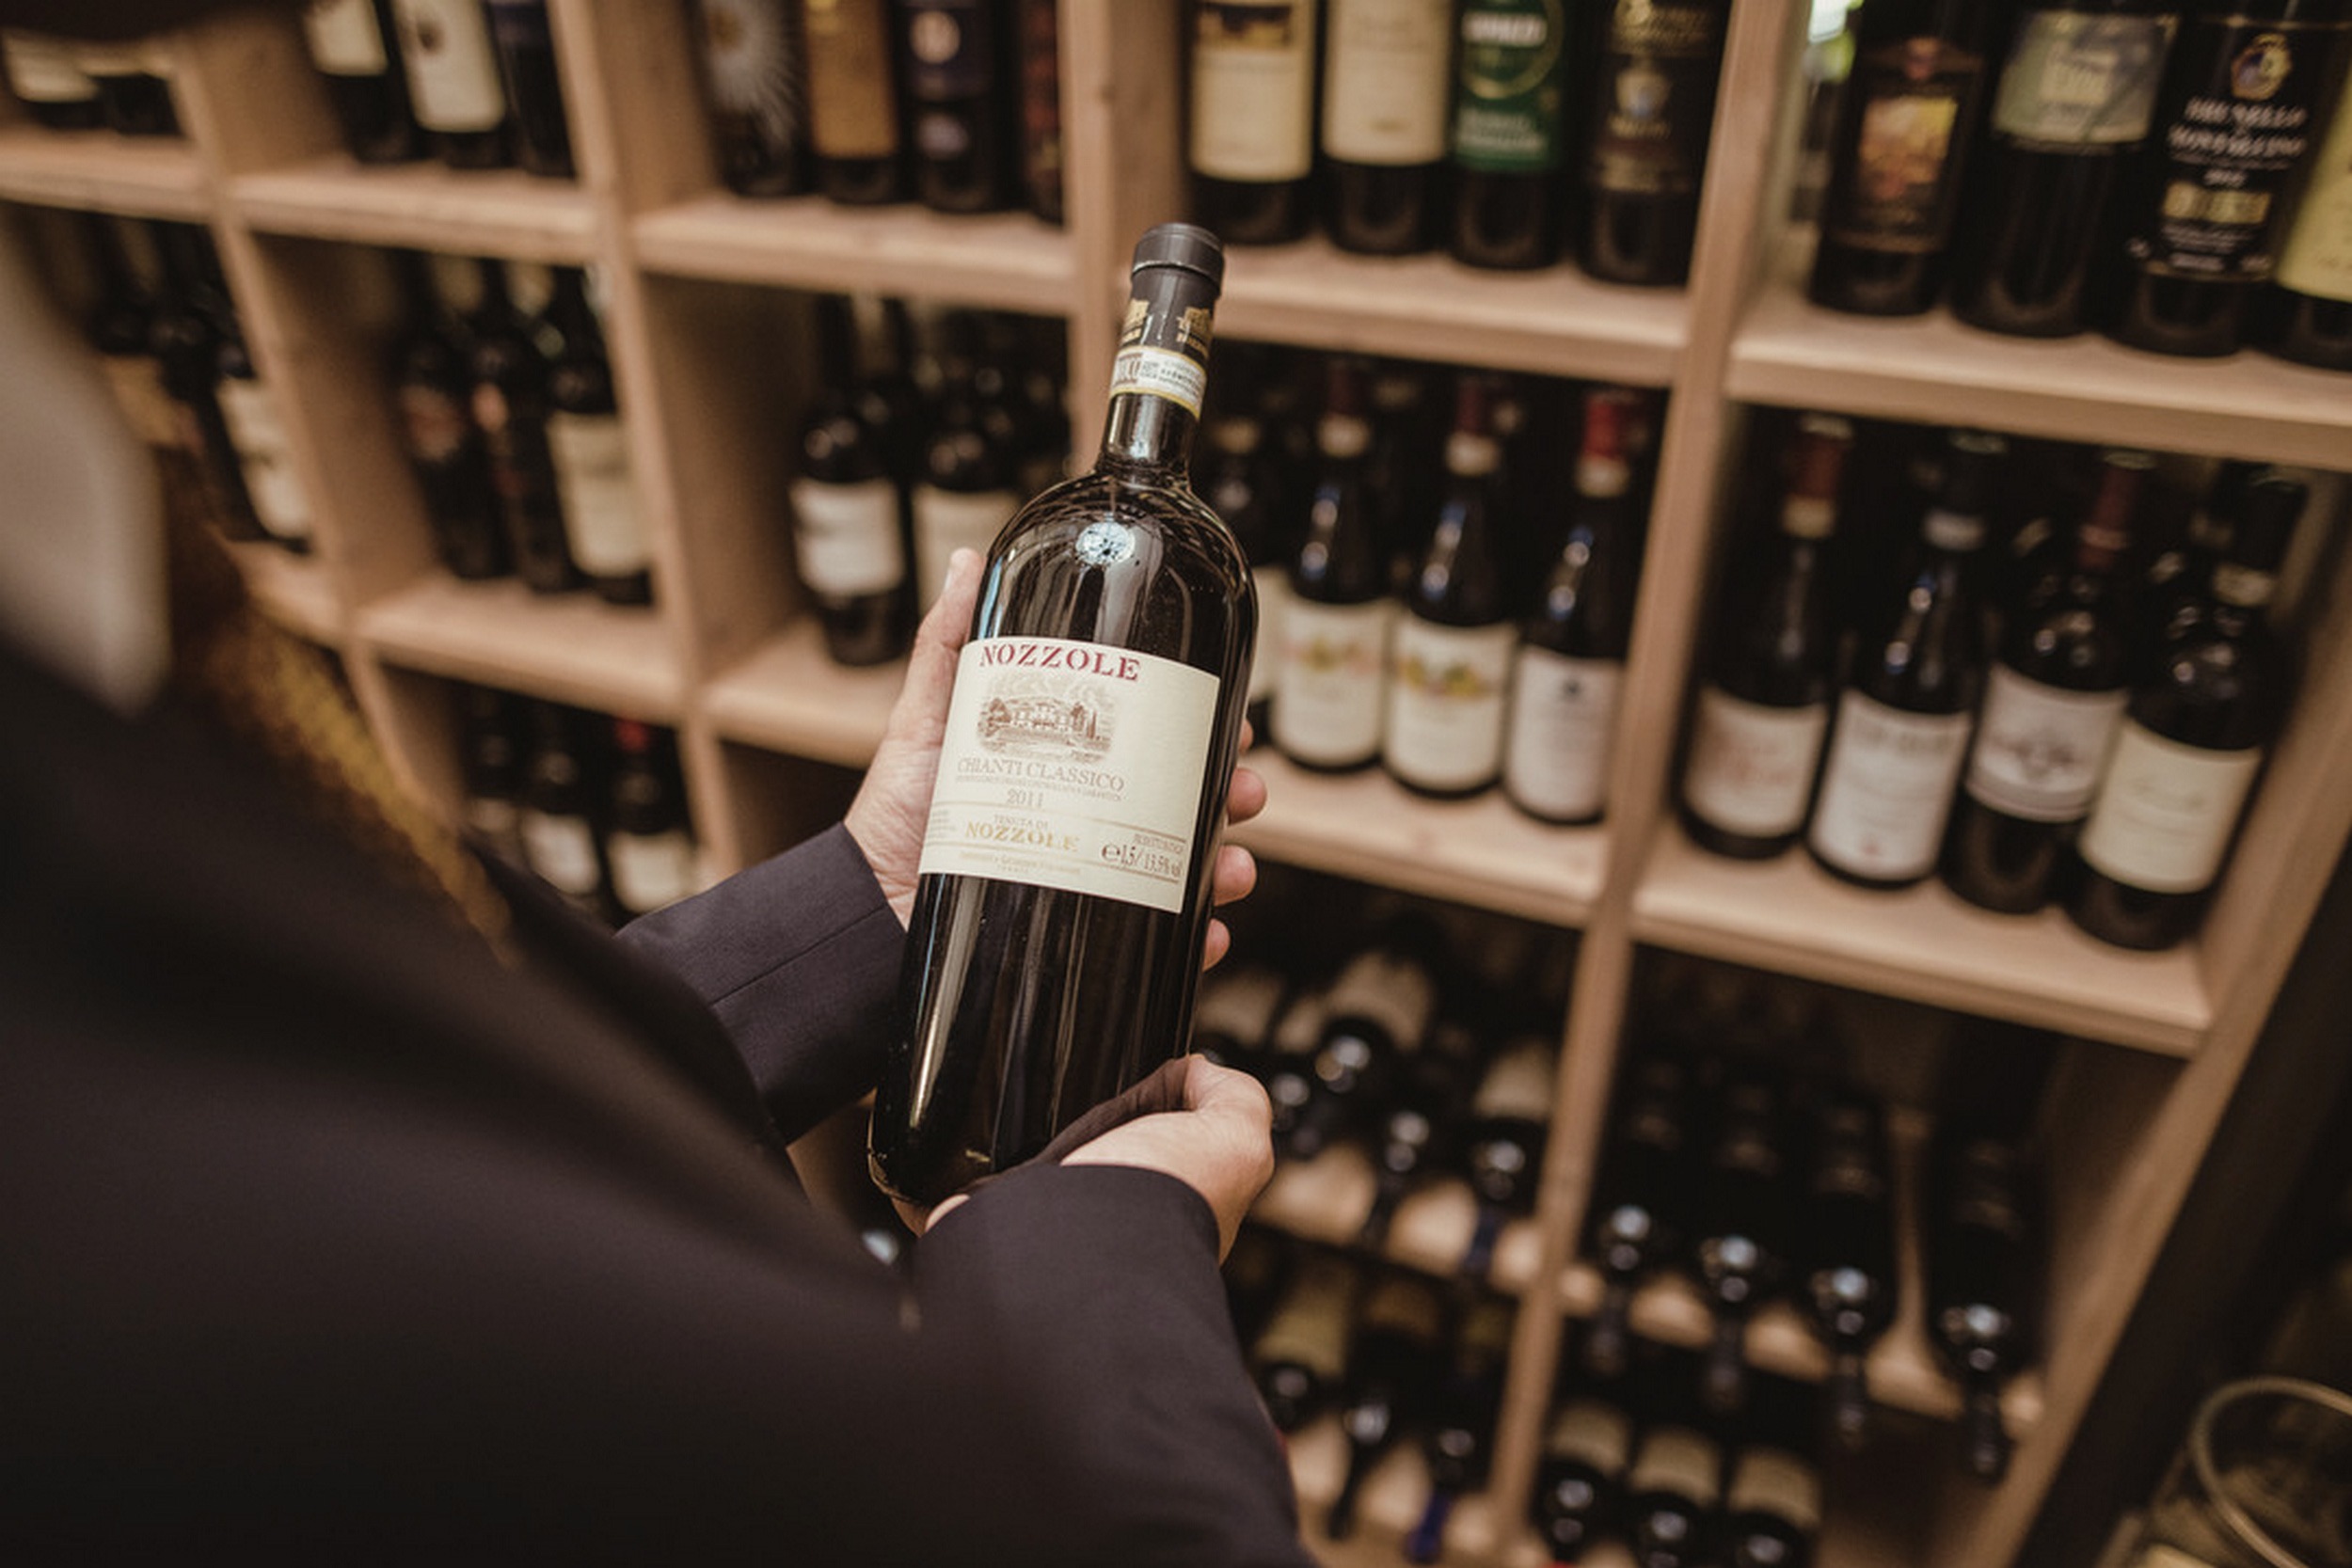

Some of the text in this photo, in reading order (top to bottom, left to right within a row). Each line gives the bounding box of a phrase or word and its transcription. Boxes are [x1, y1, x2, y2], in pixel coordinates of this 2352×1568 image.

[979, 643, 1141, 681] NOZZOLE
[957, 757, 1023, 776] CHIANTI
[1026, 762, 1125, 792] CLASSICO
[1006, 788, 1043, 808] 2011
[964, 821, 1080, 851] NOZZOLE
